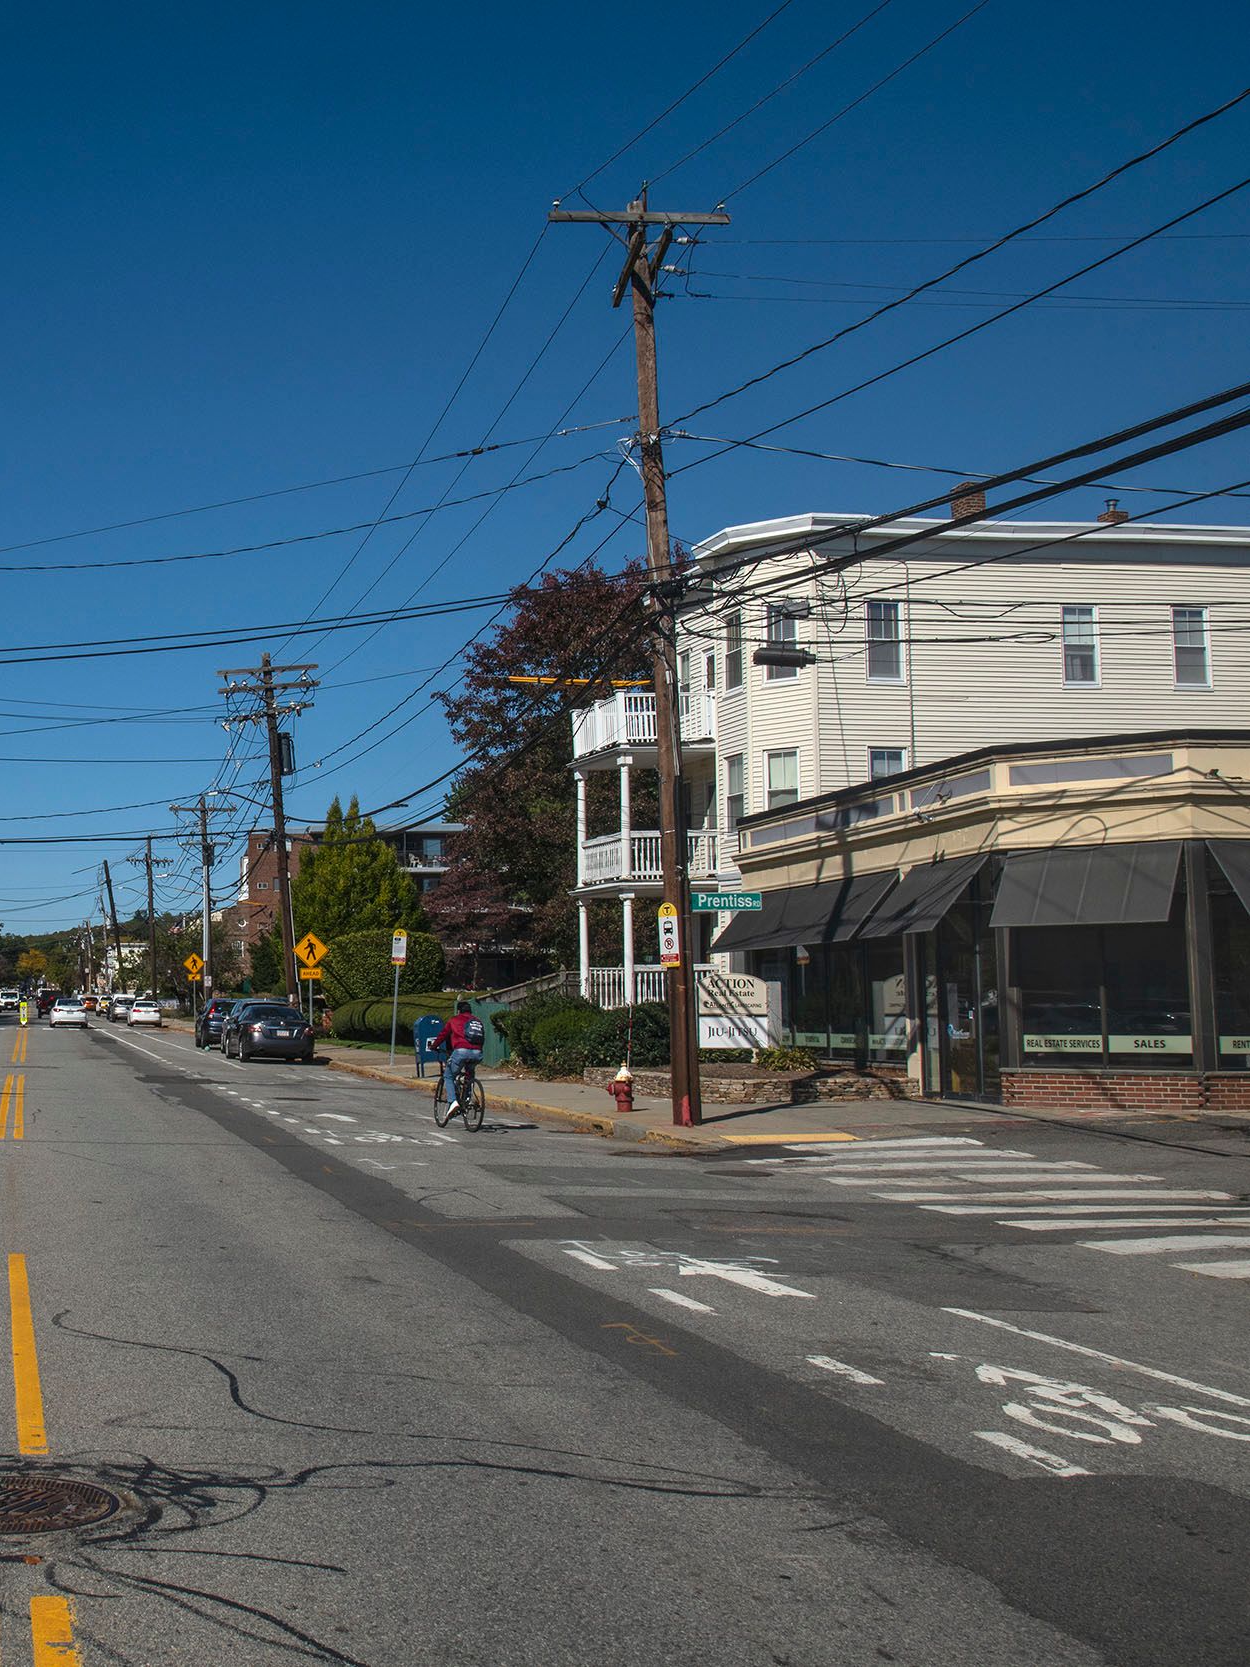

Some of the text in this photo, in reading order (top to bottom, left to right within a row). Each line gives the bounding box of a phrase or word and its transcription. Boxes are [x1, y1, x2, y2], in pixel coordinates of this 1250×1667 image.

[698, 894, 752, 907] Prentiss
[708, 979, 755, 989] ACTION
[709, 989, 727, 997] Real
[708, 1026, 758, 1038] JIU-JITSU
[1026, 1039, 1101, 1048] REAL ESTATE SERVICES
[1133, 1039, 1167, 1049] SALES
